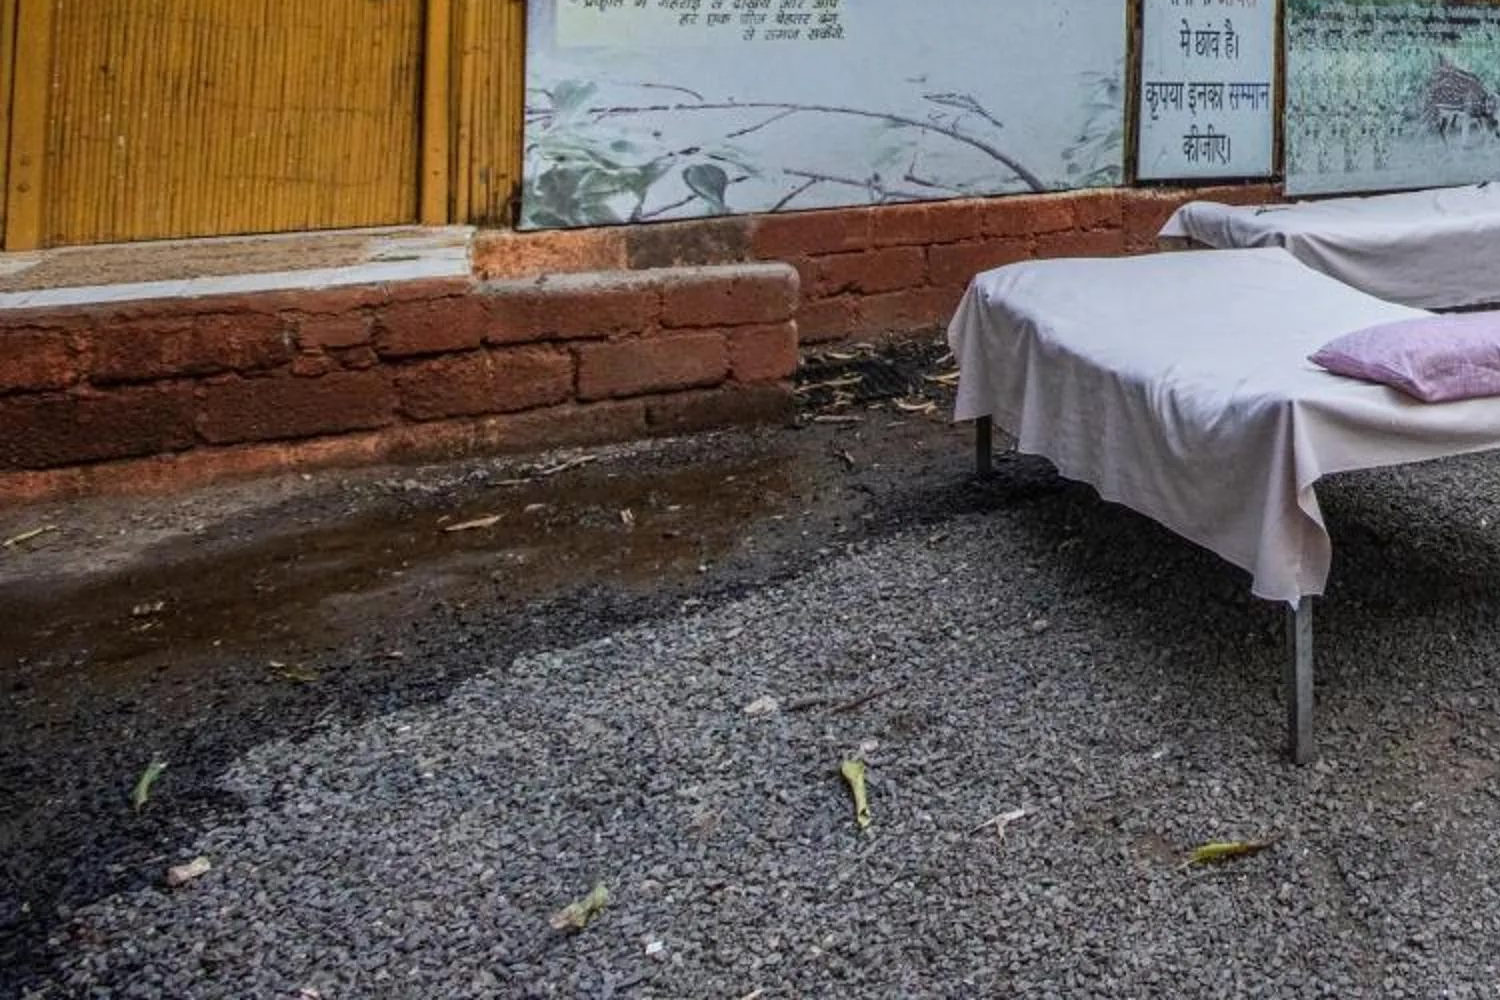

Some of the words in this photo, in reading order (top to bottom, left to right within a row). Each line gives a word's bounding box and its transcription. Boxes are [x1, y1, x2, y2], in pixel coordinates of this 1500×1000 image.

[1195, 23, 1220, 58] छांव
[1145, 82, 1184, 120] कृपया
[1187, 82, 1225, 115] इनका
[1228, 82, 1271, 112] सम्मान
